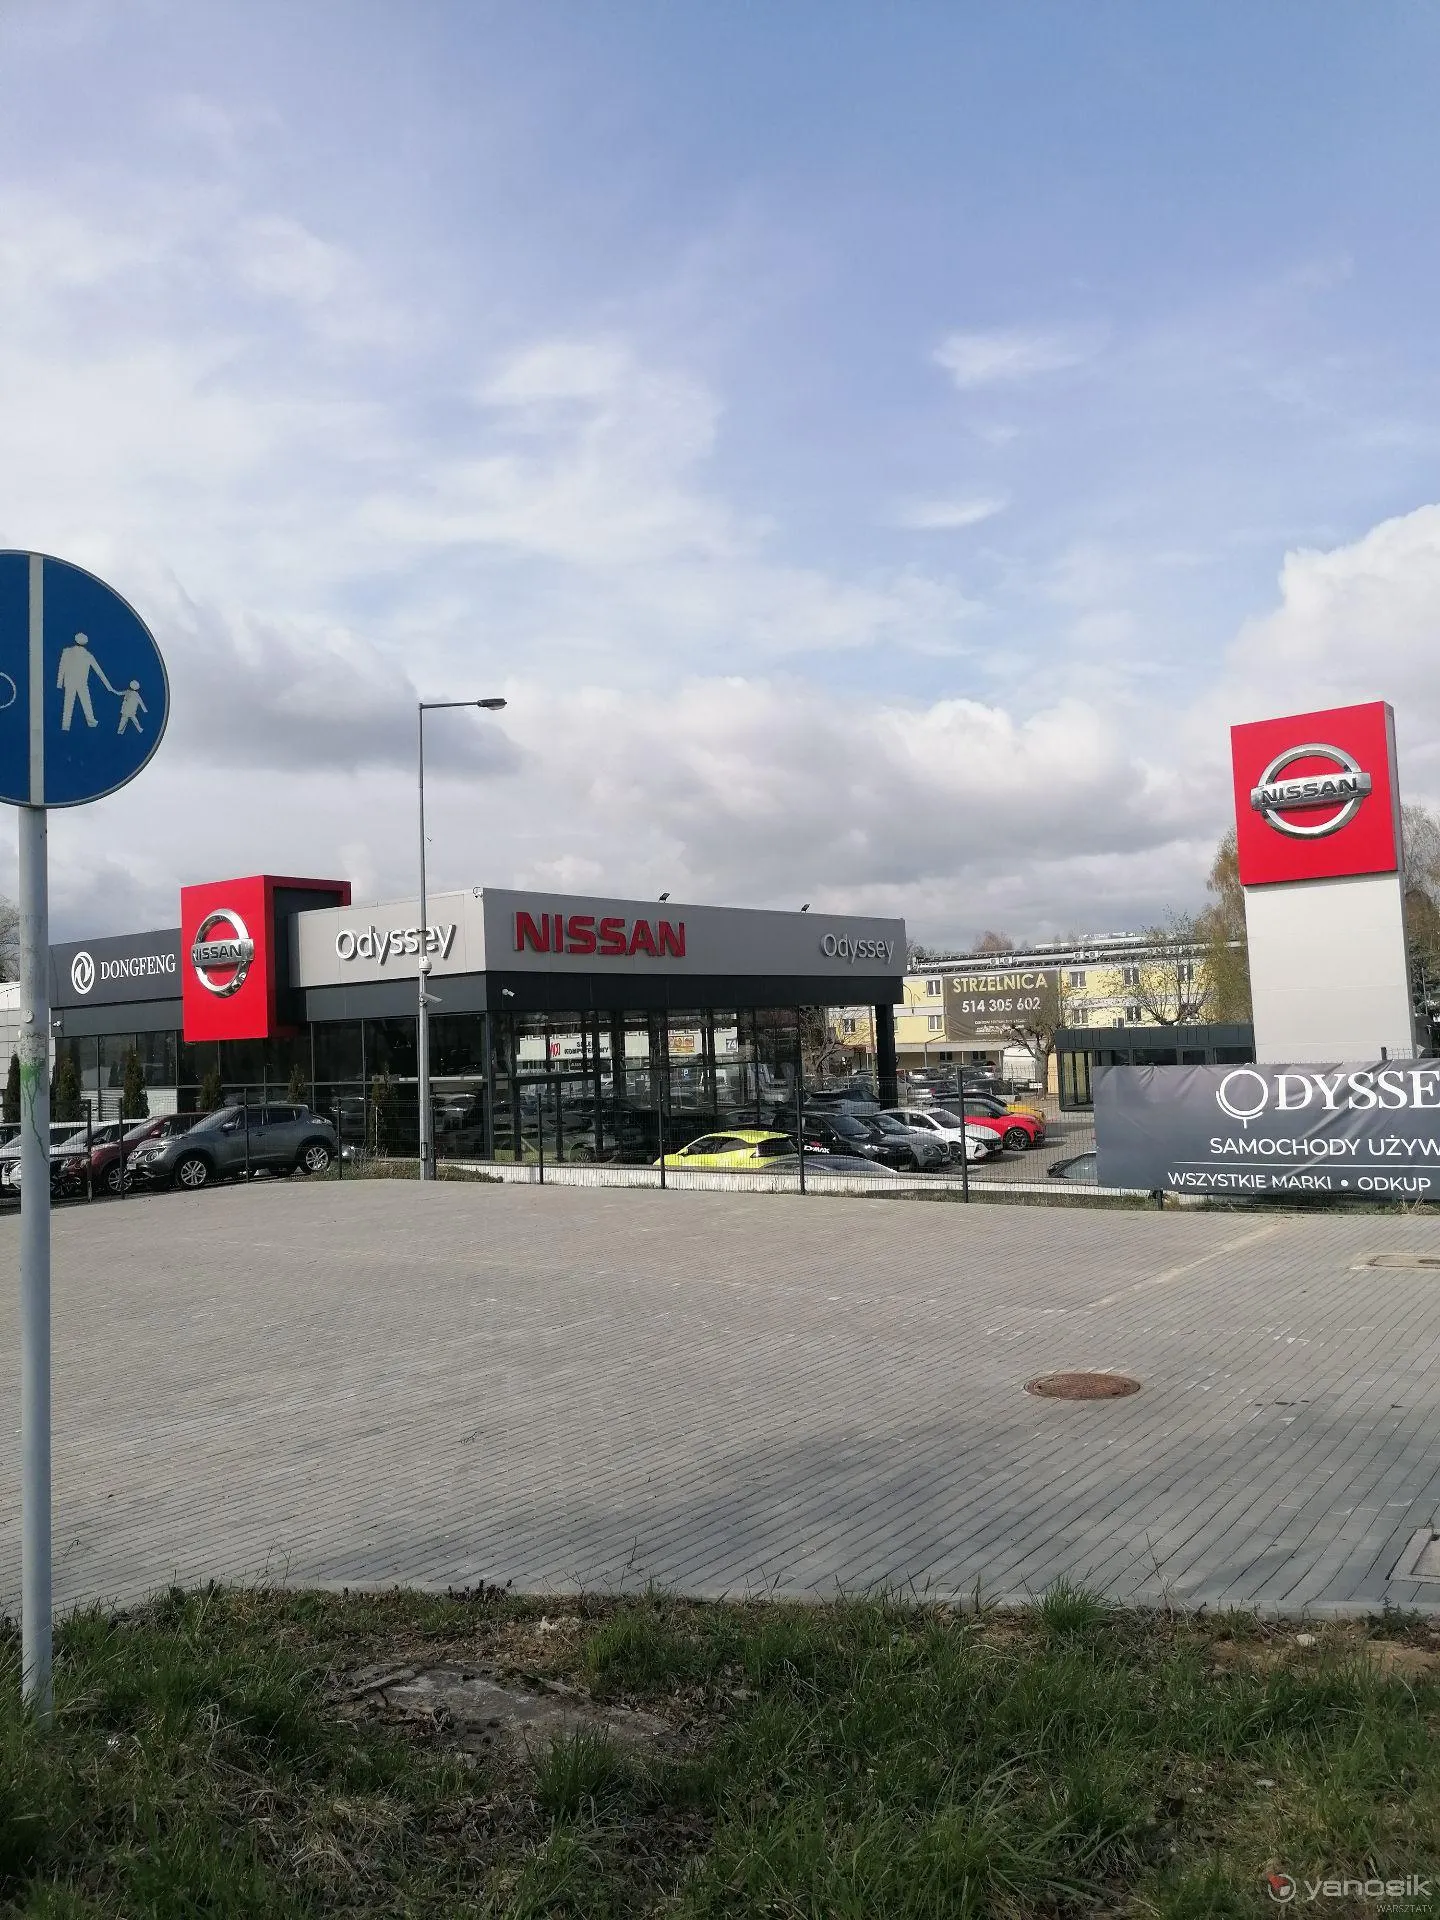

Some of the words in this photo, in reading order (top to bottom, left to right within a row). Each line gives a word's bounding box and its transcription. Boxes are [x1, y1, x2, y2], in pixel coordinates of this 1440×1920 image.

[1261, 776, 1357, 803] NISSAN
[335, 924, 457, 966] Odyssey
[513, 911, 686, 958] NISSAN
[192, 943, 242, 962] NISSAN
[821, 932, 895, 965] Odyssey
[100, 953, 176, 980] DONGFENG
[952, 972, 1048, 993] STRZELNICA
[961, 999, 986, 1013] 514
[988, 998, 1013, 1012] 305
[1016, 996, 1041, 1011] 602
[726, 1039, 737, 1049] 74
[1209, 1137, 1360, 1156] SAMOCHODY
[1167, 1171, 1267, 1188] WSZYSTKIE
[1271, 1174, 1332, 1190] MARKI
[1357, 1176, 1431, 1192] ODKUP
